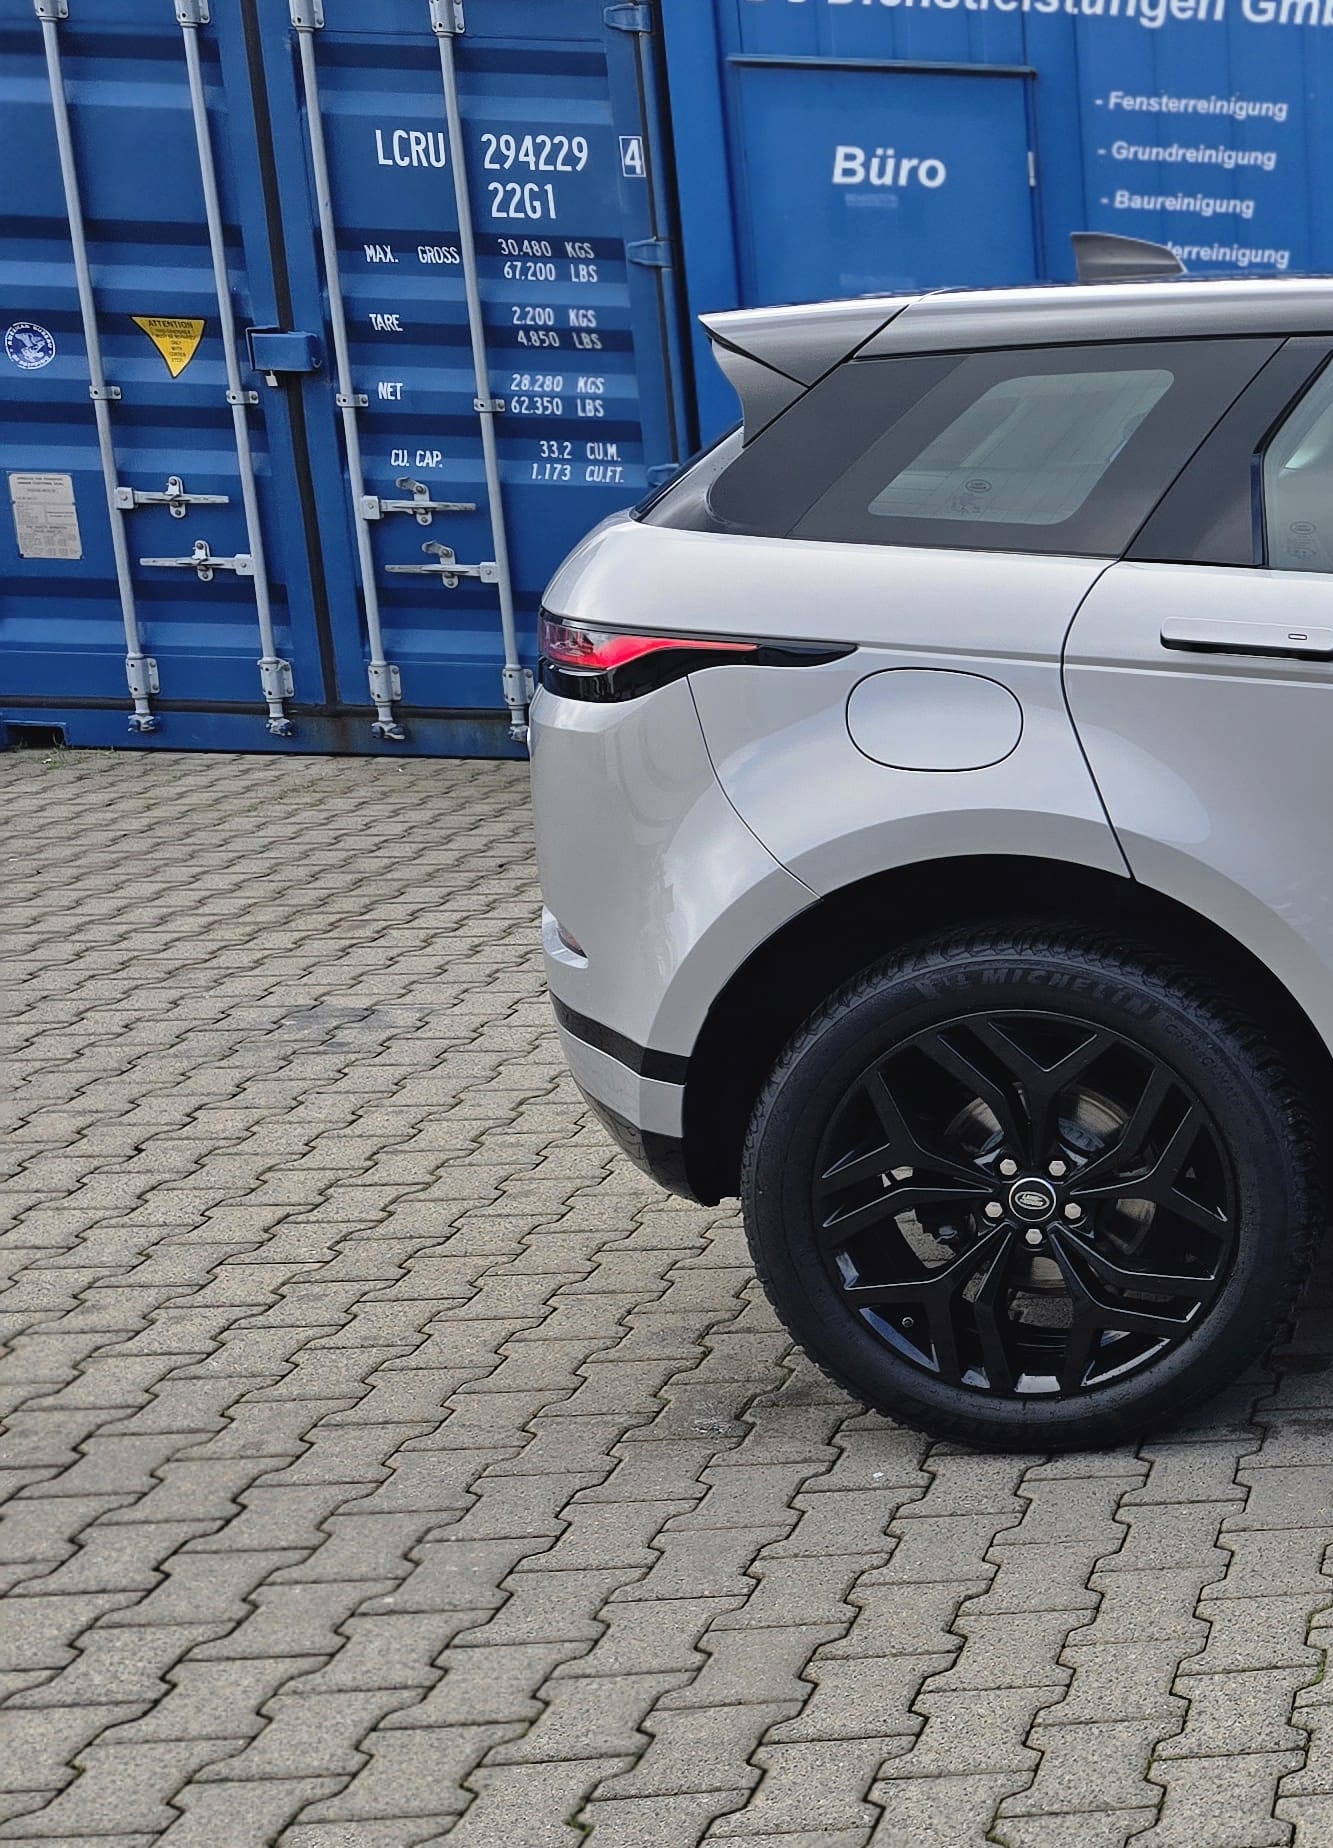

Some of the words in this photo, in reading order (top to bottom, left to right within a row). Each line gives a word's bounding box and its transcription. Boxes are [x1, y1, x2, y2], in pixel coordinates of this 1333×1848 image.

[1108, 91, 1289, 122] Fensterreinigung
[375, 129, 446, 168] LCRU
[480, 133, 588, 172] 294229
[623, 139, 643, 174] 4
[1111, 140, 1277, 171] Grundreinigung
[832, 145, 946, 188] Büro
[487, 181, 557, 220] 22G1
[1114, 189, 1255, 219] Baureinigung
[363, 244, 399, 263] MAX.
[417, 246, 460, 264] GROSS
[497, 238, 552, 257] 30.480
[564, 241, 595, 259] KGS
[503, 261, 556, 281] 67.200
[570, 263, 598, 283] LBS
[368, 313, 404, 332] TARE
[511, 306, 554, 326] 2.200
[568, 308, 597, 328] KGS
[517, 329, 560, 347] 4.850
[572, 332, 603, 350] LBS
[377, 381, 404, 400] NET
[510, 373, 563, 392] 28.280
[577, 376, 605, 394] KGS
[510, 396, 563, 415] 62.350
[576, 398, 604, 417] LBS
[390, 449, 410, 467] CU.
[415, 450, 443, 468] CAP.
[539, 440, 572, 459] 33.2
[586, 442, 621, 462] CU.M.
[531, 463, 571, 481] 1.173
[585, 465, 624, 483] CU.FT.
